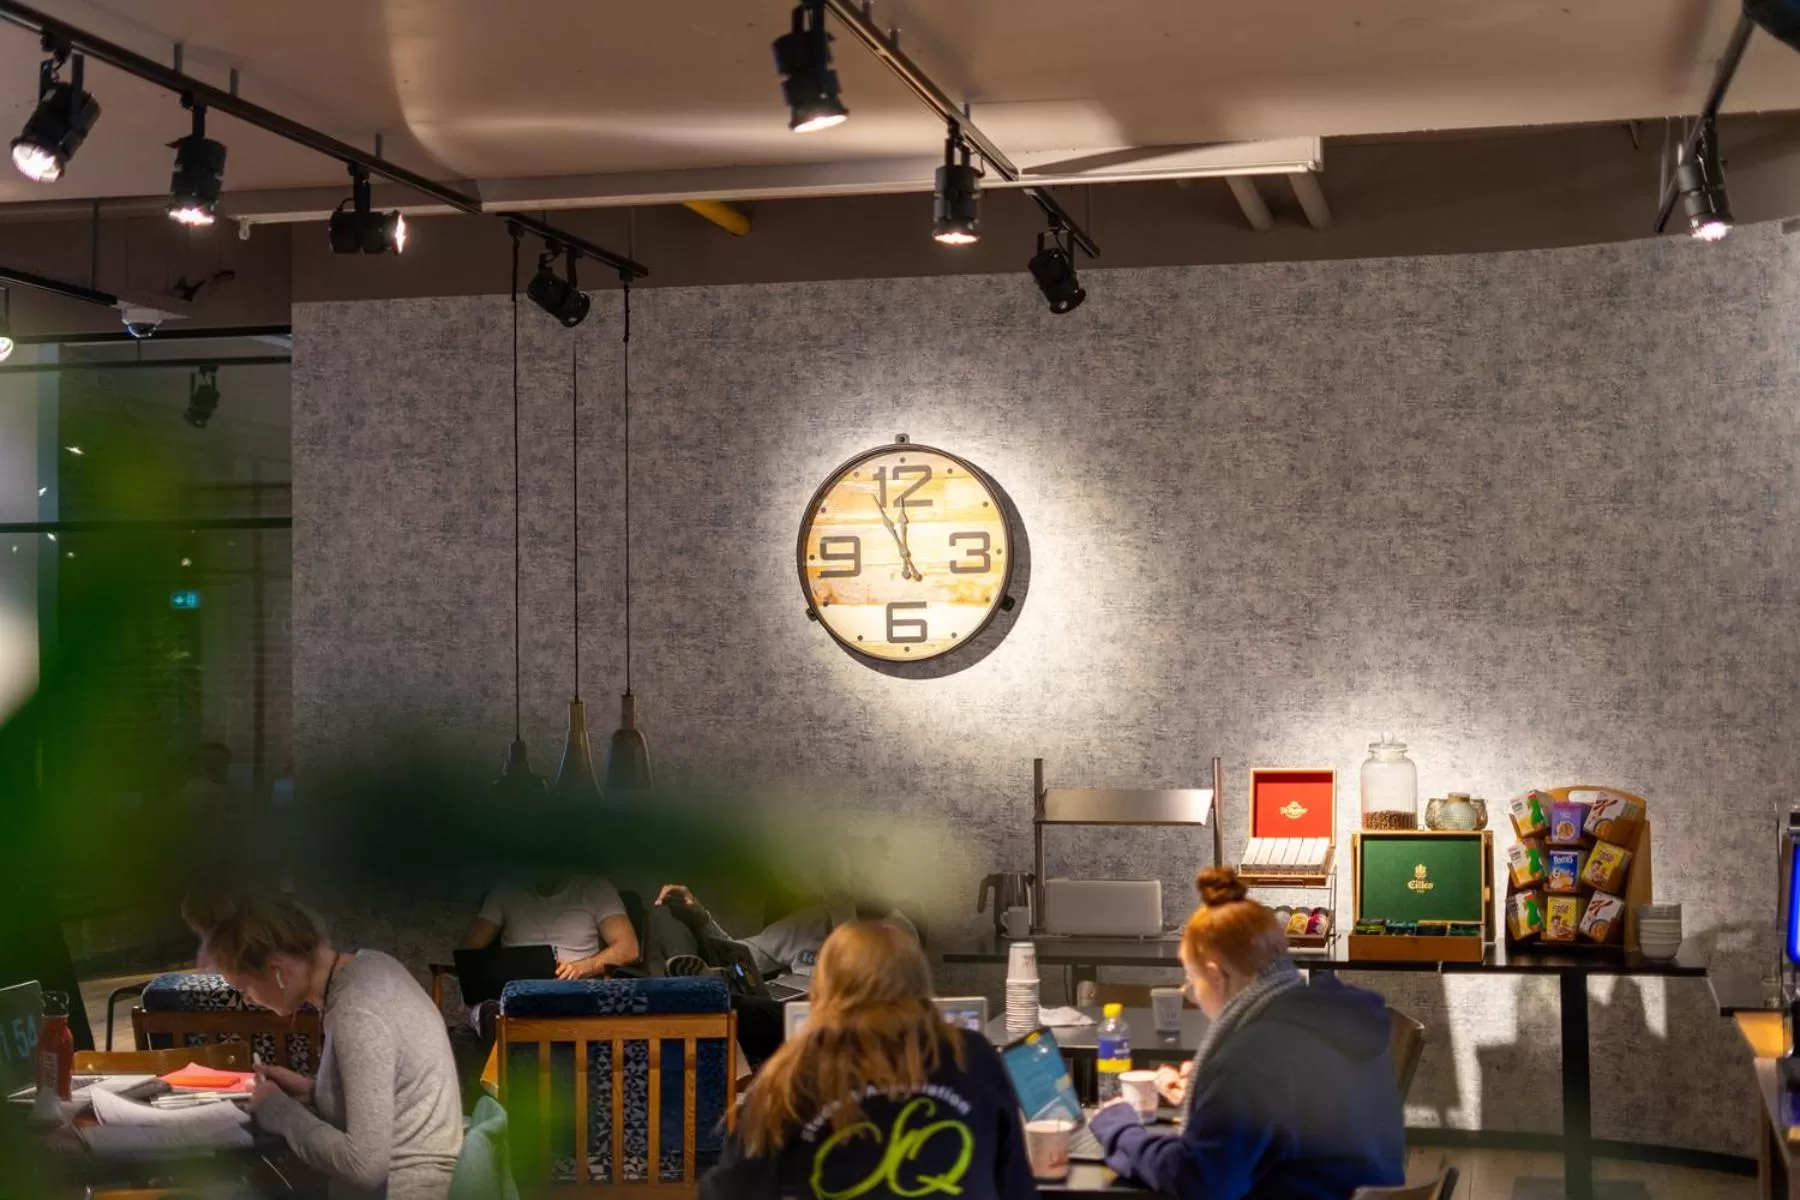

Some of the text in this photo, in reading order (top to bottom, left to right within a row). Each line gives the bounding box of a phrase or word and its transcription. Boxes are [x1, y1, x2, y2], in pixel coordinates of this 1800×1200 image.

[873, 465, 933, 508] 12
[818, 536, 861, 578] 9
[949, 532, 991, 574] 3
[886, 601, 927, 643] 6
